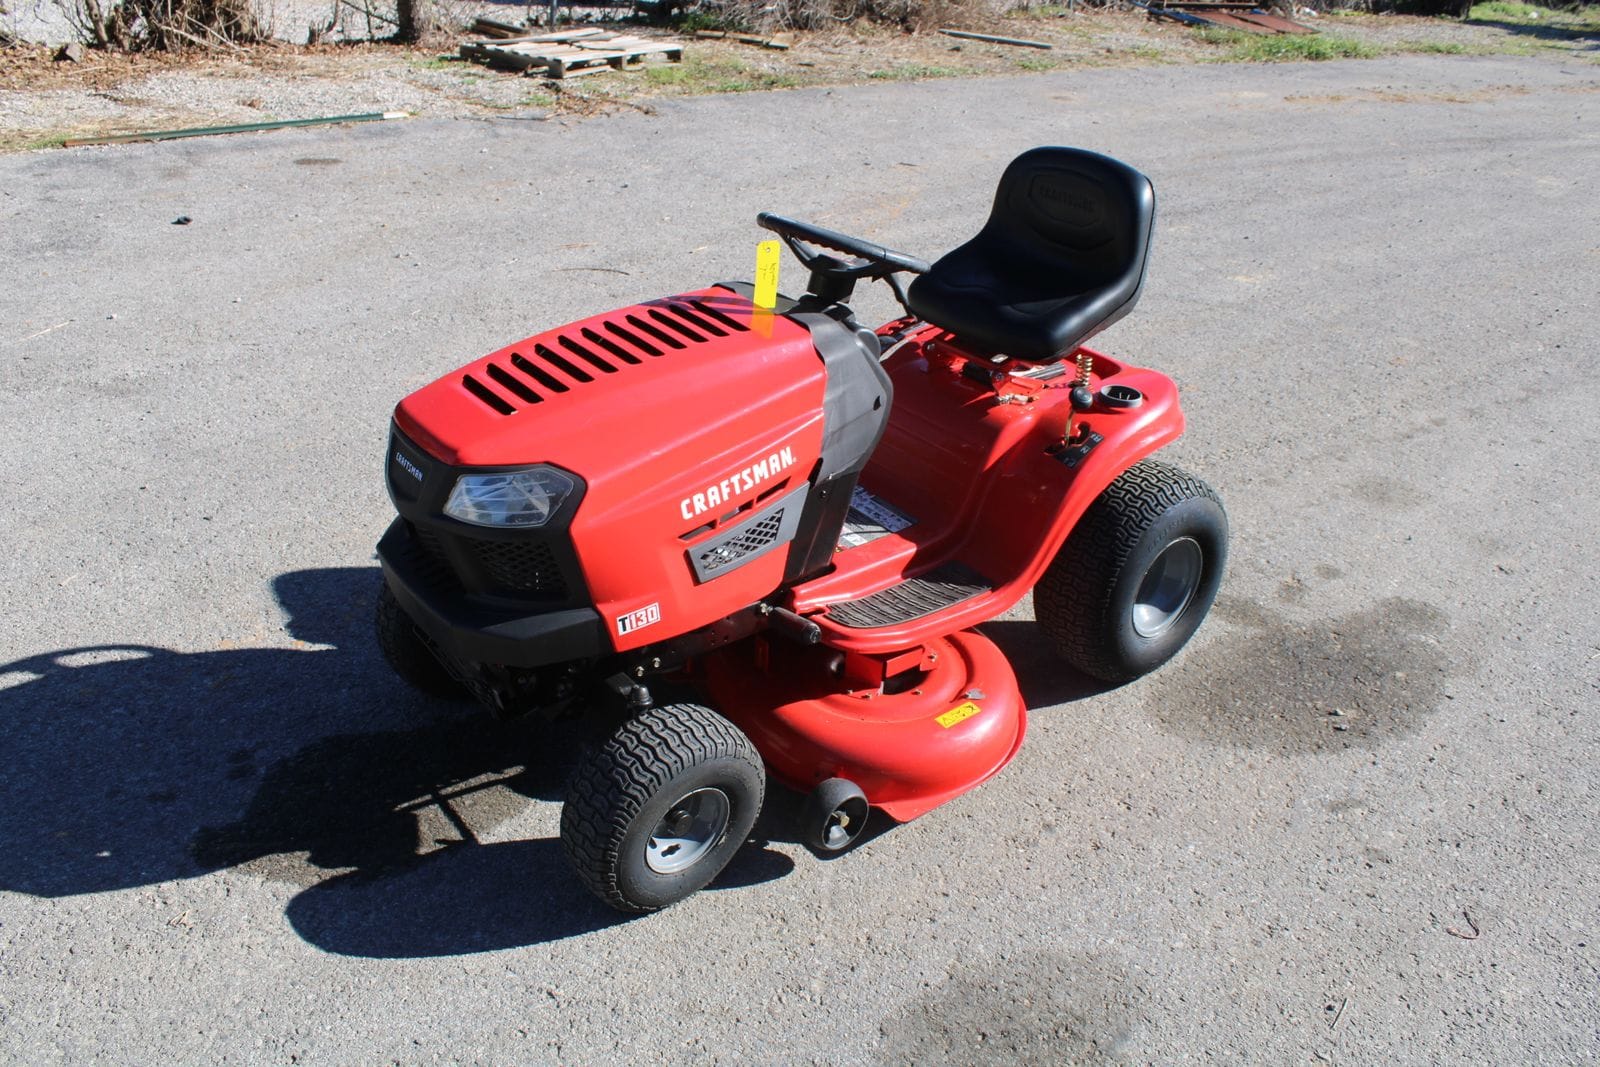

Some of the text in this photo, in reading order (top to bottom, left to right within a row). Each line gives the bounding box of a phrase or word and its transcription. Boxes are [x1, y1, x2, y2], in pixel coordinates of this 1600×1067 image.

[396, 451, 423, 481] CRAFTSMAN
[680, 446, 793, 520] CRAFTSMAN
[618, 604, 659, 632] T130
